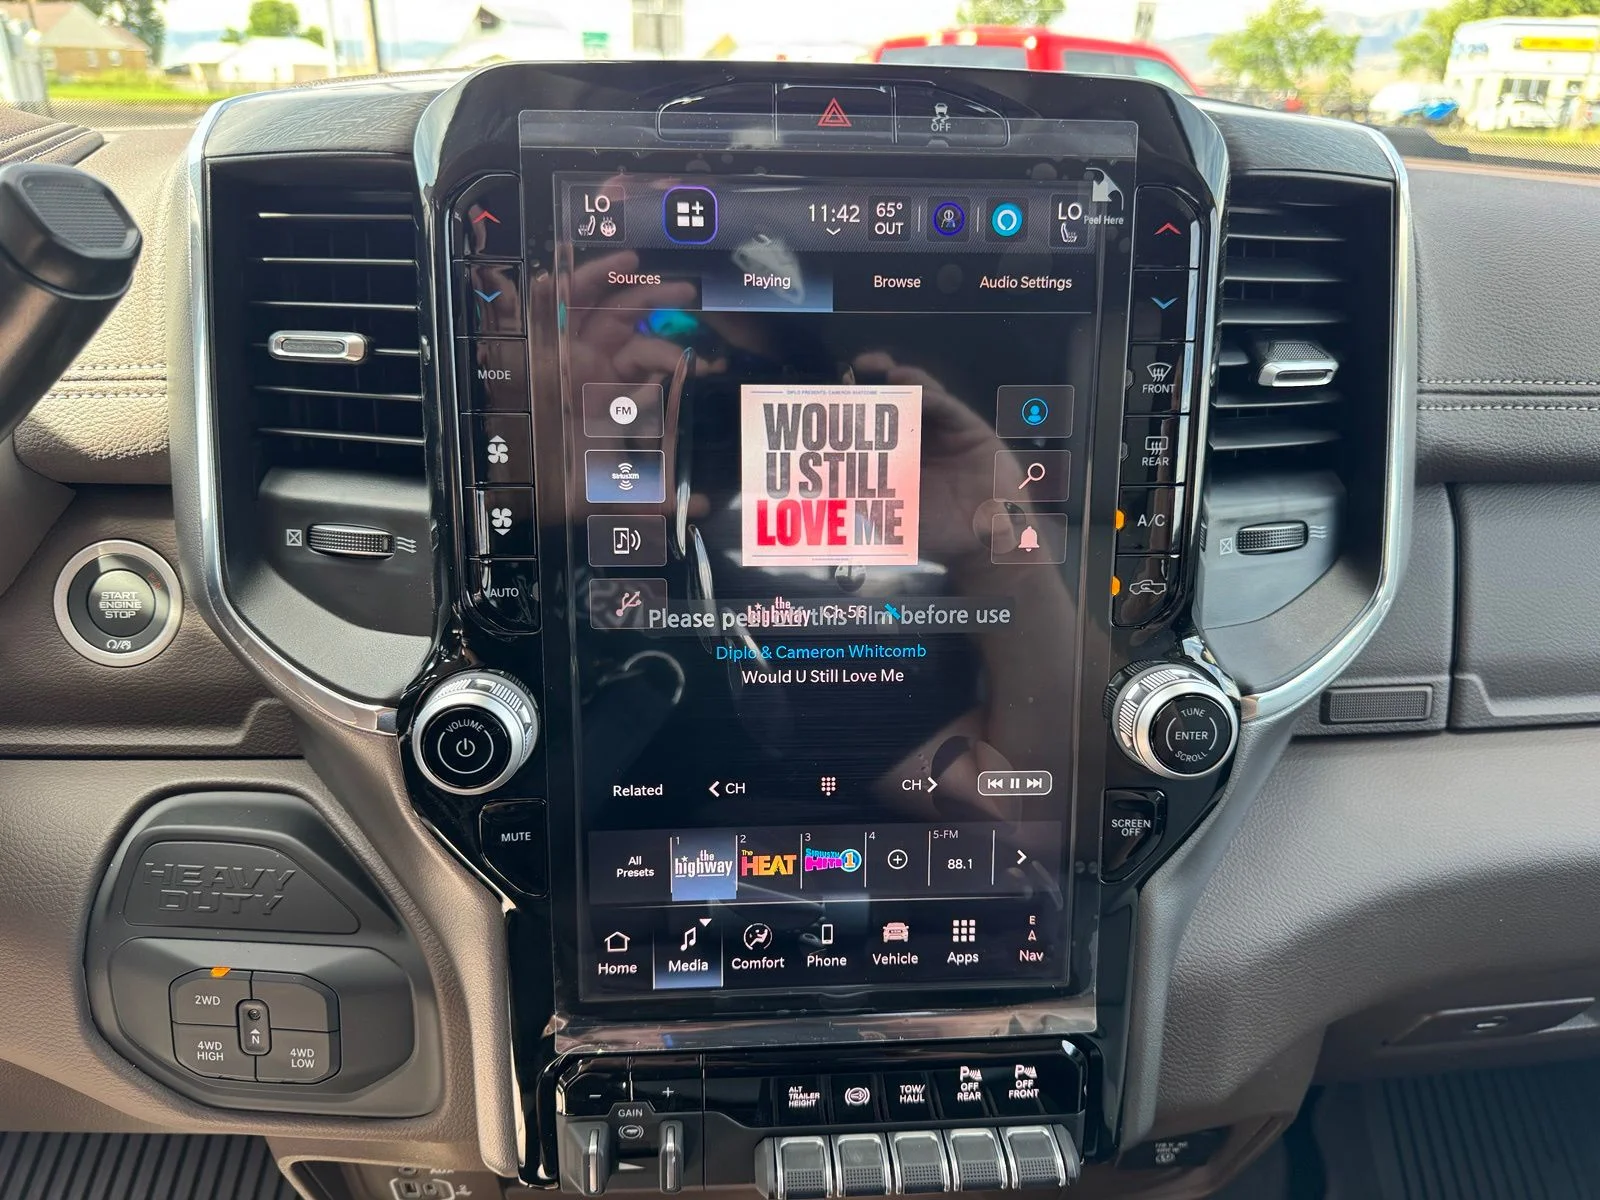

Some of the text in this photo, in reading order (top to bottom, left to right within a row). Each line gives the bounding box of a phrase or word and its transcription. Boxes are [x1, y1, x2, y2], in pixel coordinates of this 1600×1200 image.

[931, 122, 951, 132] OFF
[584, 194, 611, 213] LO
[808, 204, 861, 223] 11:42
[876, 202, 903, 217] 65°
[1058, 202, 1082, 222] LO
[1084, 215, 1124, 225] Peel Here
[874, 222, 904, 235] OUT
[608, 270, 661, 285] Sources
[744, 273, 791, 290] Playing
[874, 275, 921, 289] Browse
[980, 276, 1072, 293] Audio Settings
[478, 370, 512, 380] MODE
[1142, 384, 1176, 394] FRONT
[616, 406, 632, 416] FM
[762, 403, 899, 451] WOULD
[1142, 457, 1170, 466] REAR
[766, 451, 896, 499] U STILL
[757, 500, 904, 546] LOVE ME
[1137, 514, 1166, 528] A/C
[101, 592, 139, 600] START
[489, 588, 520, 598] AUTO
[98, 601, 142, 609] ENGINE
[775, 596, 792, 609] the
[105, 610, 136, 619] STOP
[649, 608, 715, 628] Please
[902, 604, 968, 624] before
[976, 608, 1010, 624] use
[848, 605, 868, 618] 56
[716, 644, 927, 662] Diplo & Cameron Whitcomb
[742, 669, 904, 684] Would U Still Love Me
[1180, 707, 1206, 718] TUNE
[445, 718, 486, 734] VOLUME
[1174, 731, 1208, 740] ENTER
[1174, 751, 1208, 762] SCROLL
[613, 784, 664, 797] Related
[725, 783, 746, 794] CH
[902, 780, 922, 791] CH
[1111, 819, 1150, 828] SCREEN
[501, 832, 532, 842] MUTE
[804, 832, 812, 842] 3
[868, 832, 876, 840] 4
[933, 830, 958, 839] 5-FM
[1121, 828, 1141, 837] OFF
[675, 836, 680, 845] 1
[740, 834, 747, 844] 2
[628, 856, 642, 866] All
[700, 850, 714, 861] the
[674, 858, 733, 878] highway
[741, 855, 797, 876] HEAT
[948, 858, 973, 870] 88.1
[143, 862, 296, 892] HEAVY
[616, 867, 655, 878] Presets
[159, 889, 284, 916] DUTY
[806, 955, 847, 967] Phone
[872, 952, 918, 966] Vehicle
[947, 952, 979, 964] Apps
[1019, 950, 1044, 962] Nav
[598, 962, 638, 975] Home
[668, 959, 709, 972] Media
[732, 956, 785, 970] Comfort
[194, 994, 220, 1006] 2WD
[251, 1034, 260, 1045] N
[196, 1040, 222, 1051] 4WD
[196, 1052, 224, 1062] HIGH
[290, 1048, 314, 1058] 4WD
[291, 1058, 315, 1068] LOW
[900, 1084, 926, 1094] TOW/
[960, 1082, 979, 1092] OFF
[1015, 1079, 1034, 1089] OFF
[788, 1092, 820, 1100] TRAILER
[900, 1094, 926, 1104] HAUL
[957, 1091, 982, 1102] REAR
[1008, 1088, 1040, 1100] FRONT
[788, 1099, 816, 1108] HEIGHT
[618, 1108, 643, 1118] GAIN
